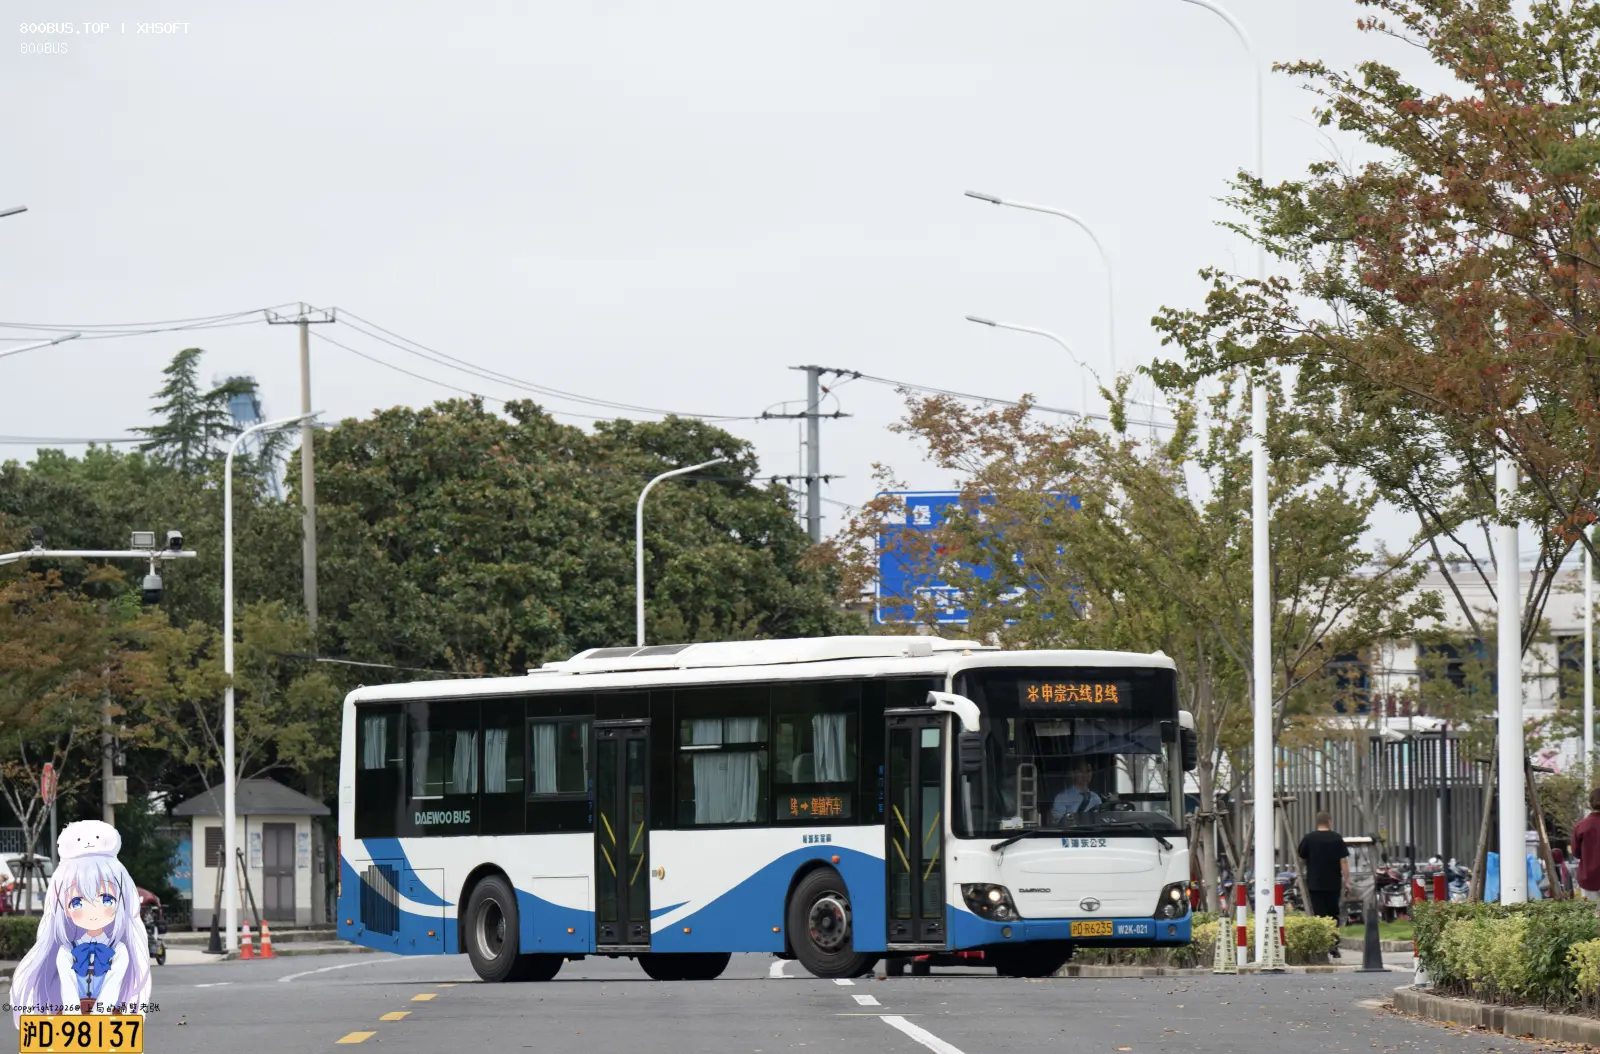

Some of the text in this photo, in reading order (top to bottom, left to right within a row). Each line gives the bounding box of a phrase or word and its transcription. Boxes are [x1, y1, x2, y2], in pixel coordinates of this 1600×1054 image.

[811, 796, 843, 816] 堡镇汽车
[415, 810, 471, 825] DAEWOO BUS
[1117, 924, 1148, 935] W2K-021
